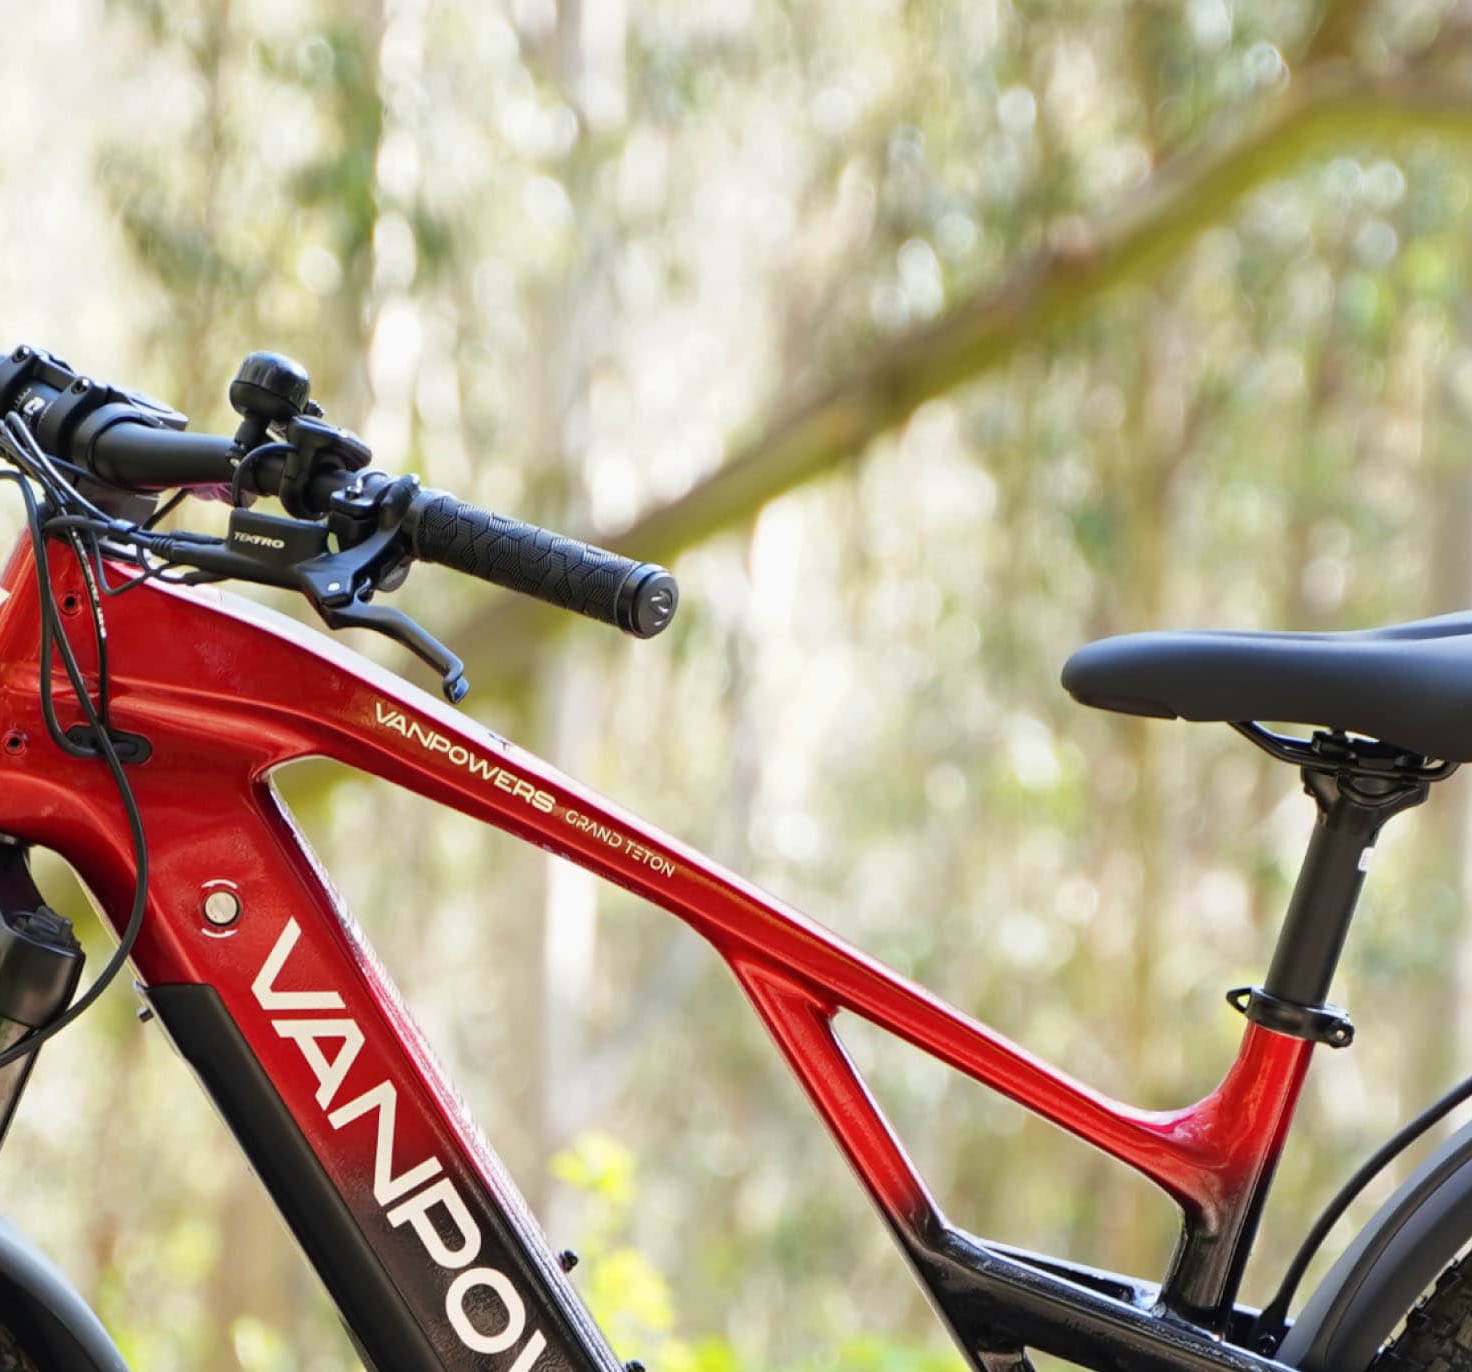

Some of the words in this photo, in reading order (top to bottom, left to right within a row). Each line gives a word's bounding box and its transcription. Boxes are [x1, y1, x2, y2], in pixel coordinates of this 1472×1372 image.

[234, 531, 285, 549] TEKTRO
[374, 702, 556, 814] VANPOWERS
[565, 809, 623, 848] GRAND
[624, 838, 676, 878] TETON
